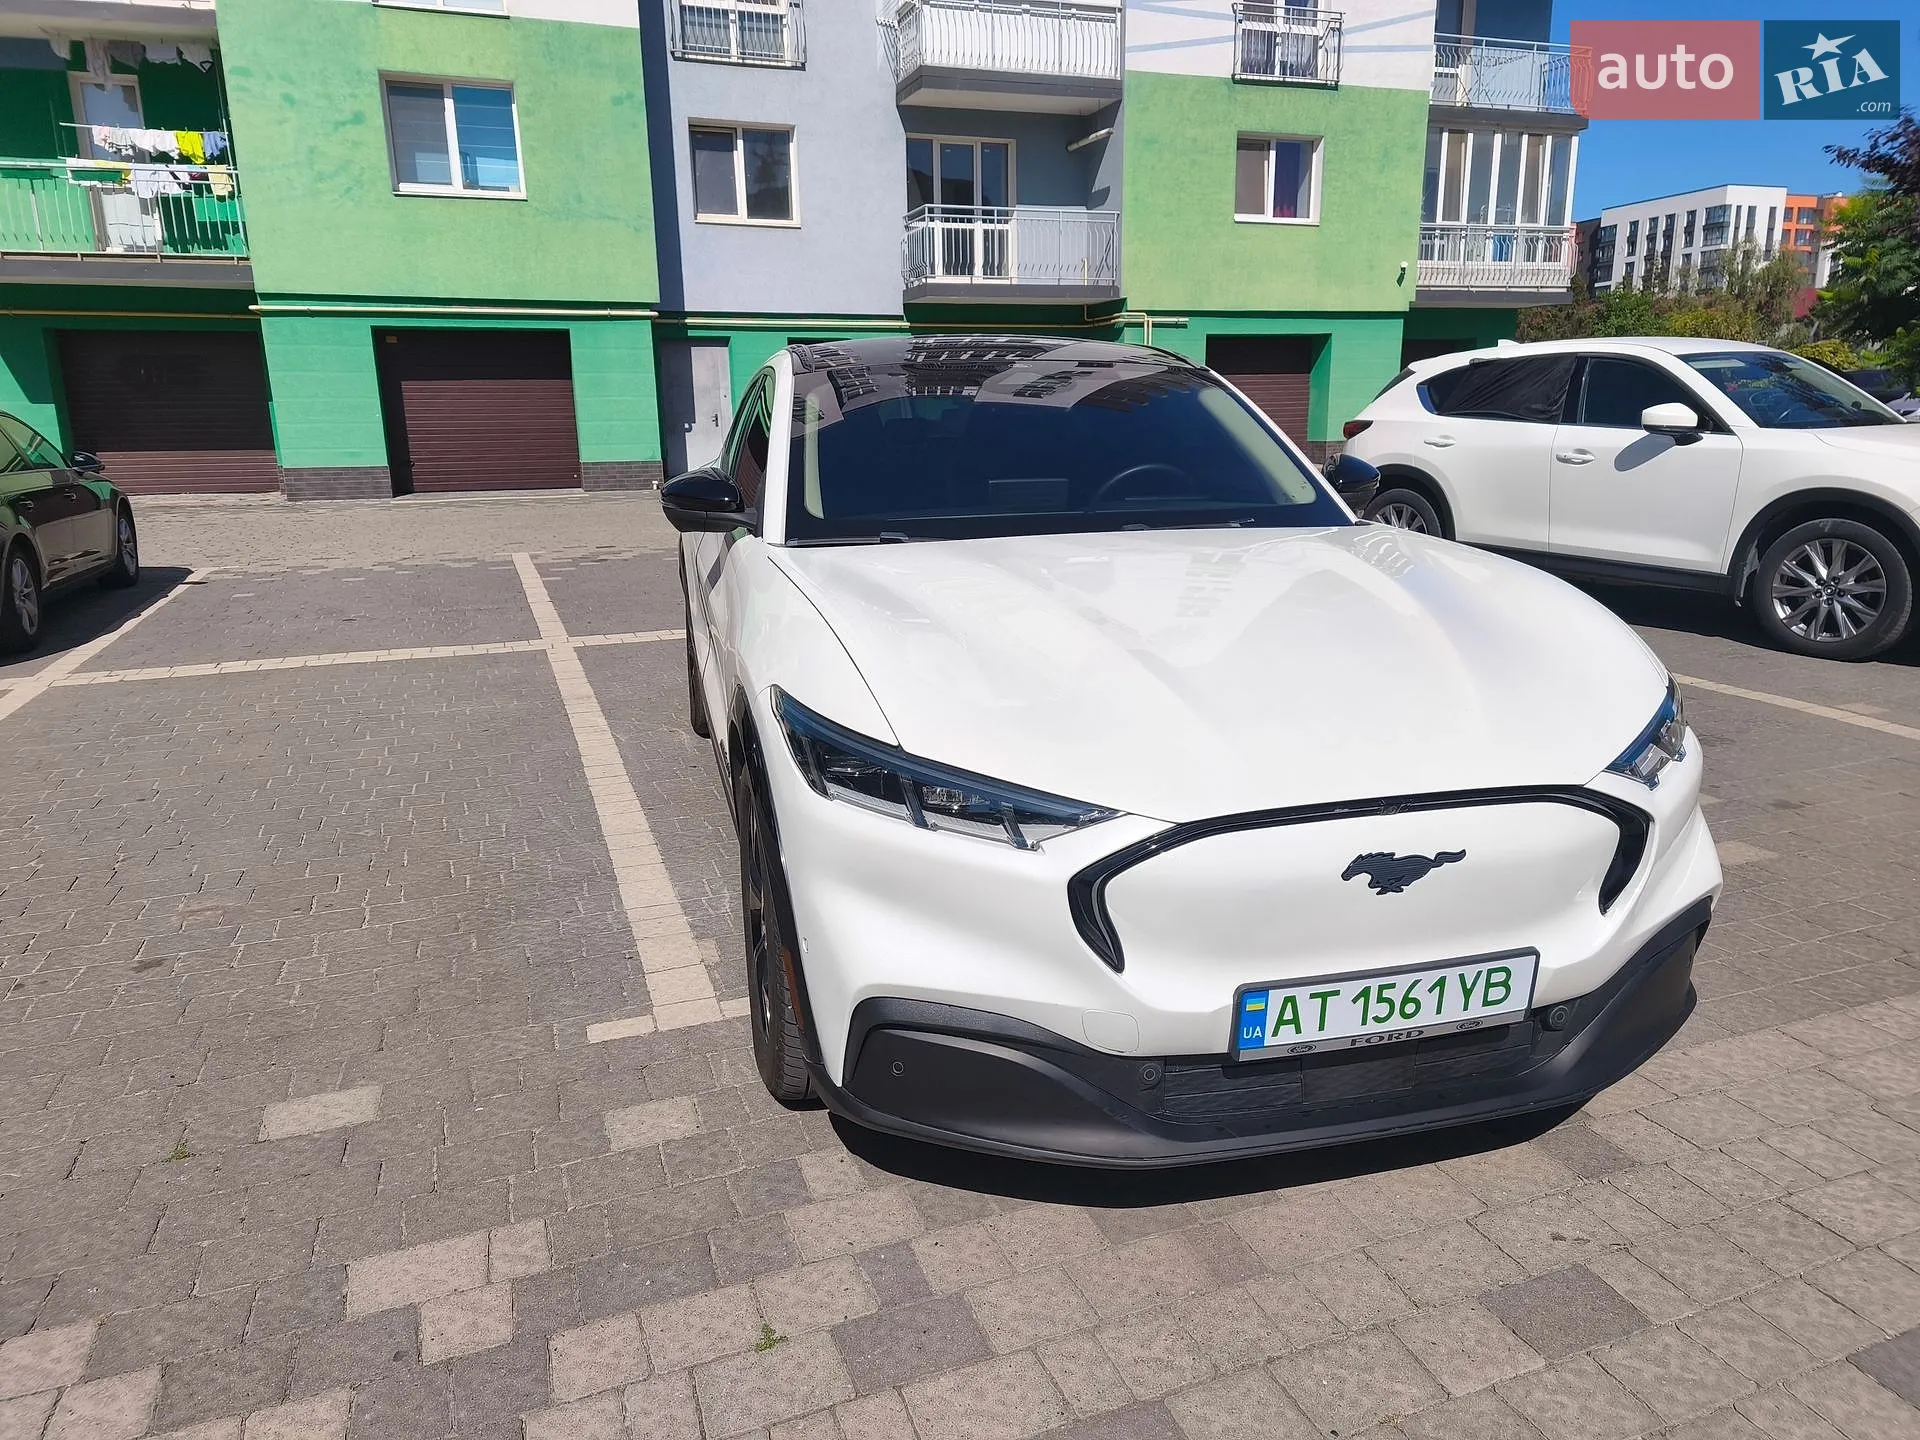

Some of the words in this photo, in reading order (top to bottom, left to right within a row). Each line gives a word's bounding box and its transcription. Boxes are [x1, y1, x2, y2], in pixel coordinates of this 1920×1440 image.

[1271, 989, 1341, 1038] AT
[1351, 975, 1447, 1026] 1561
[1458, 966, 1512, 1012] YB
[1243, 1026, 1263, 1039] UA
[1350, 1029, 1425, 1047] FORD
